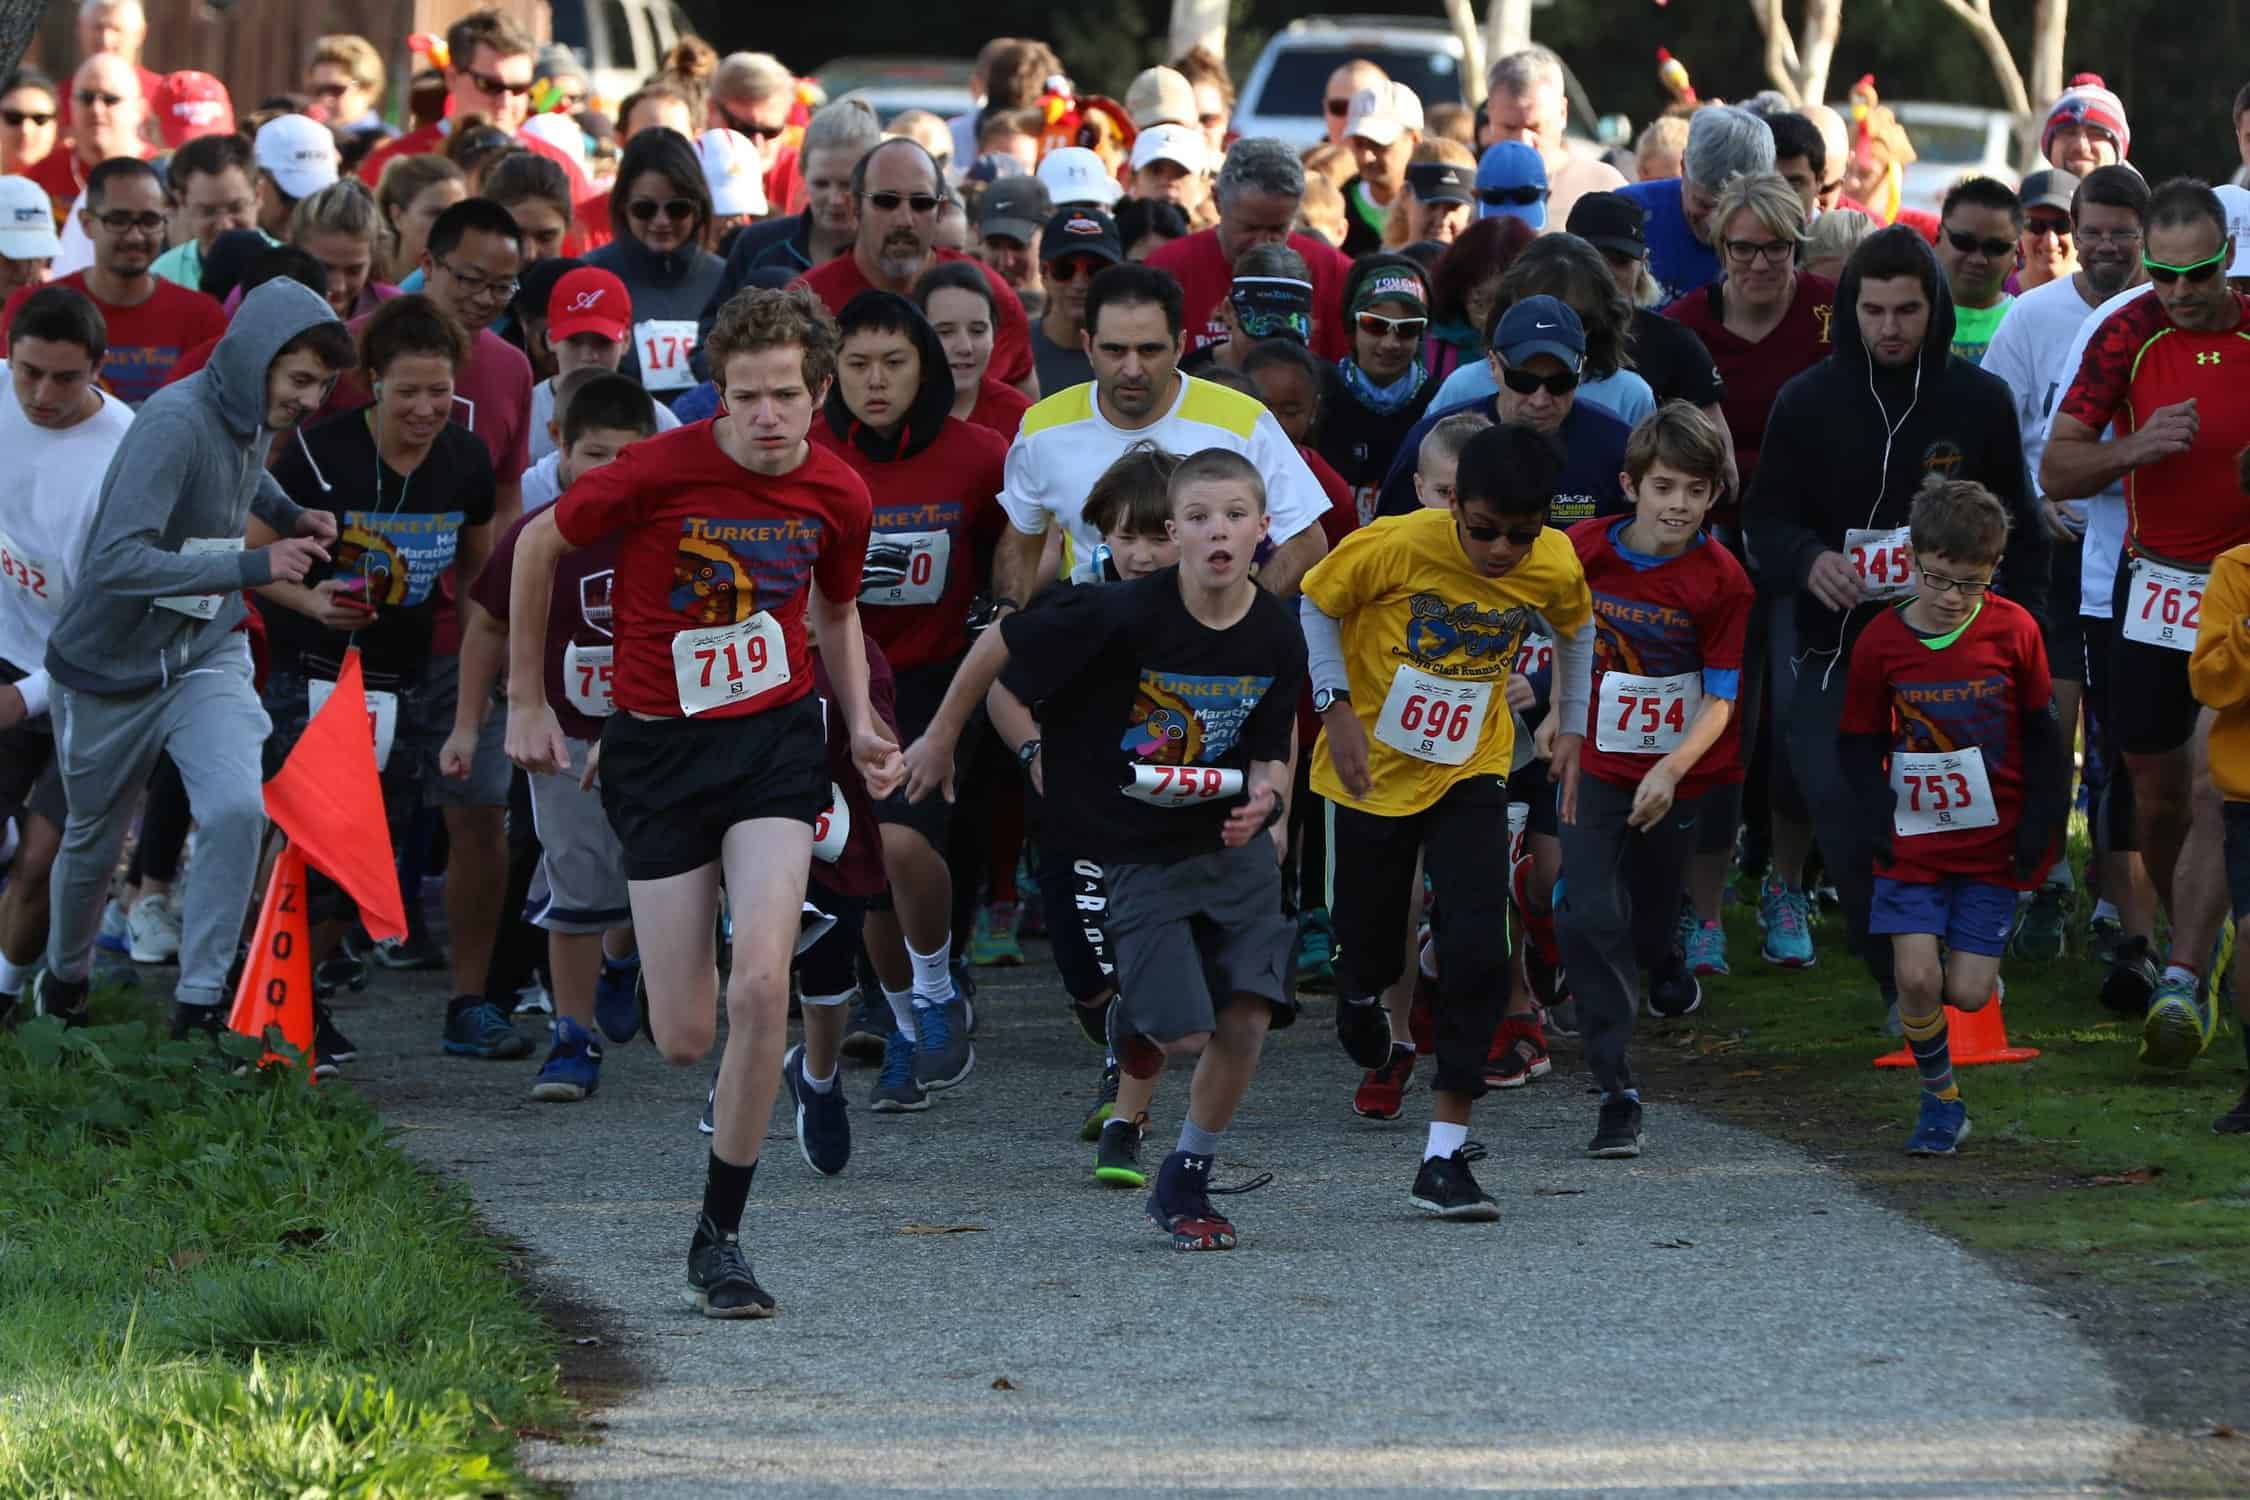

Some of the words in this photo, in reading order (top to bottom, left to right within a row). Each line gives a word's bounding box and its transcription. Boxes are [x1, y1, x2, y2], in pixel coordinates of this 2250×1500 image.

[1850, 546, 1909, 584] 345
[2142, 582, 2202, 630] 762
[694, 636, 768, 688] 719
[1401, 695, 1472, 742] 696
[1617, 695, 1685, 733] 754
[1904, 773, 1972, 812] 753
